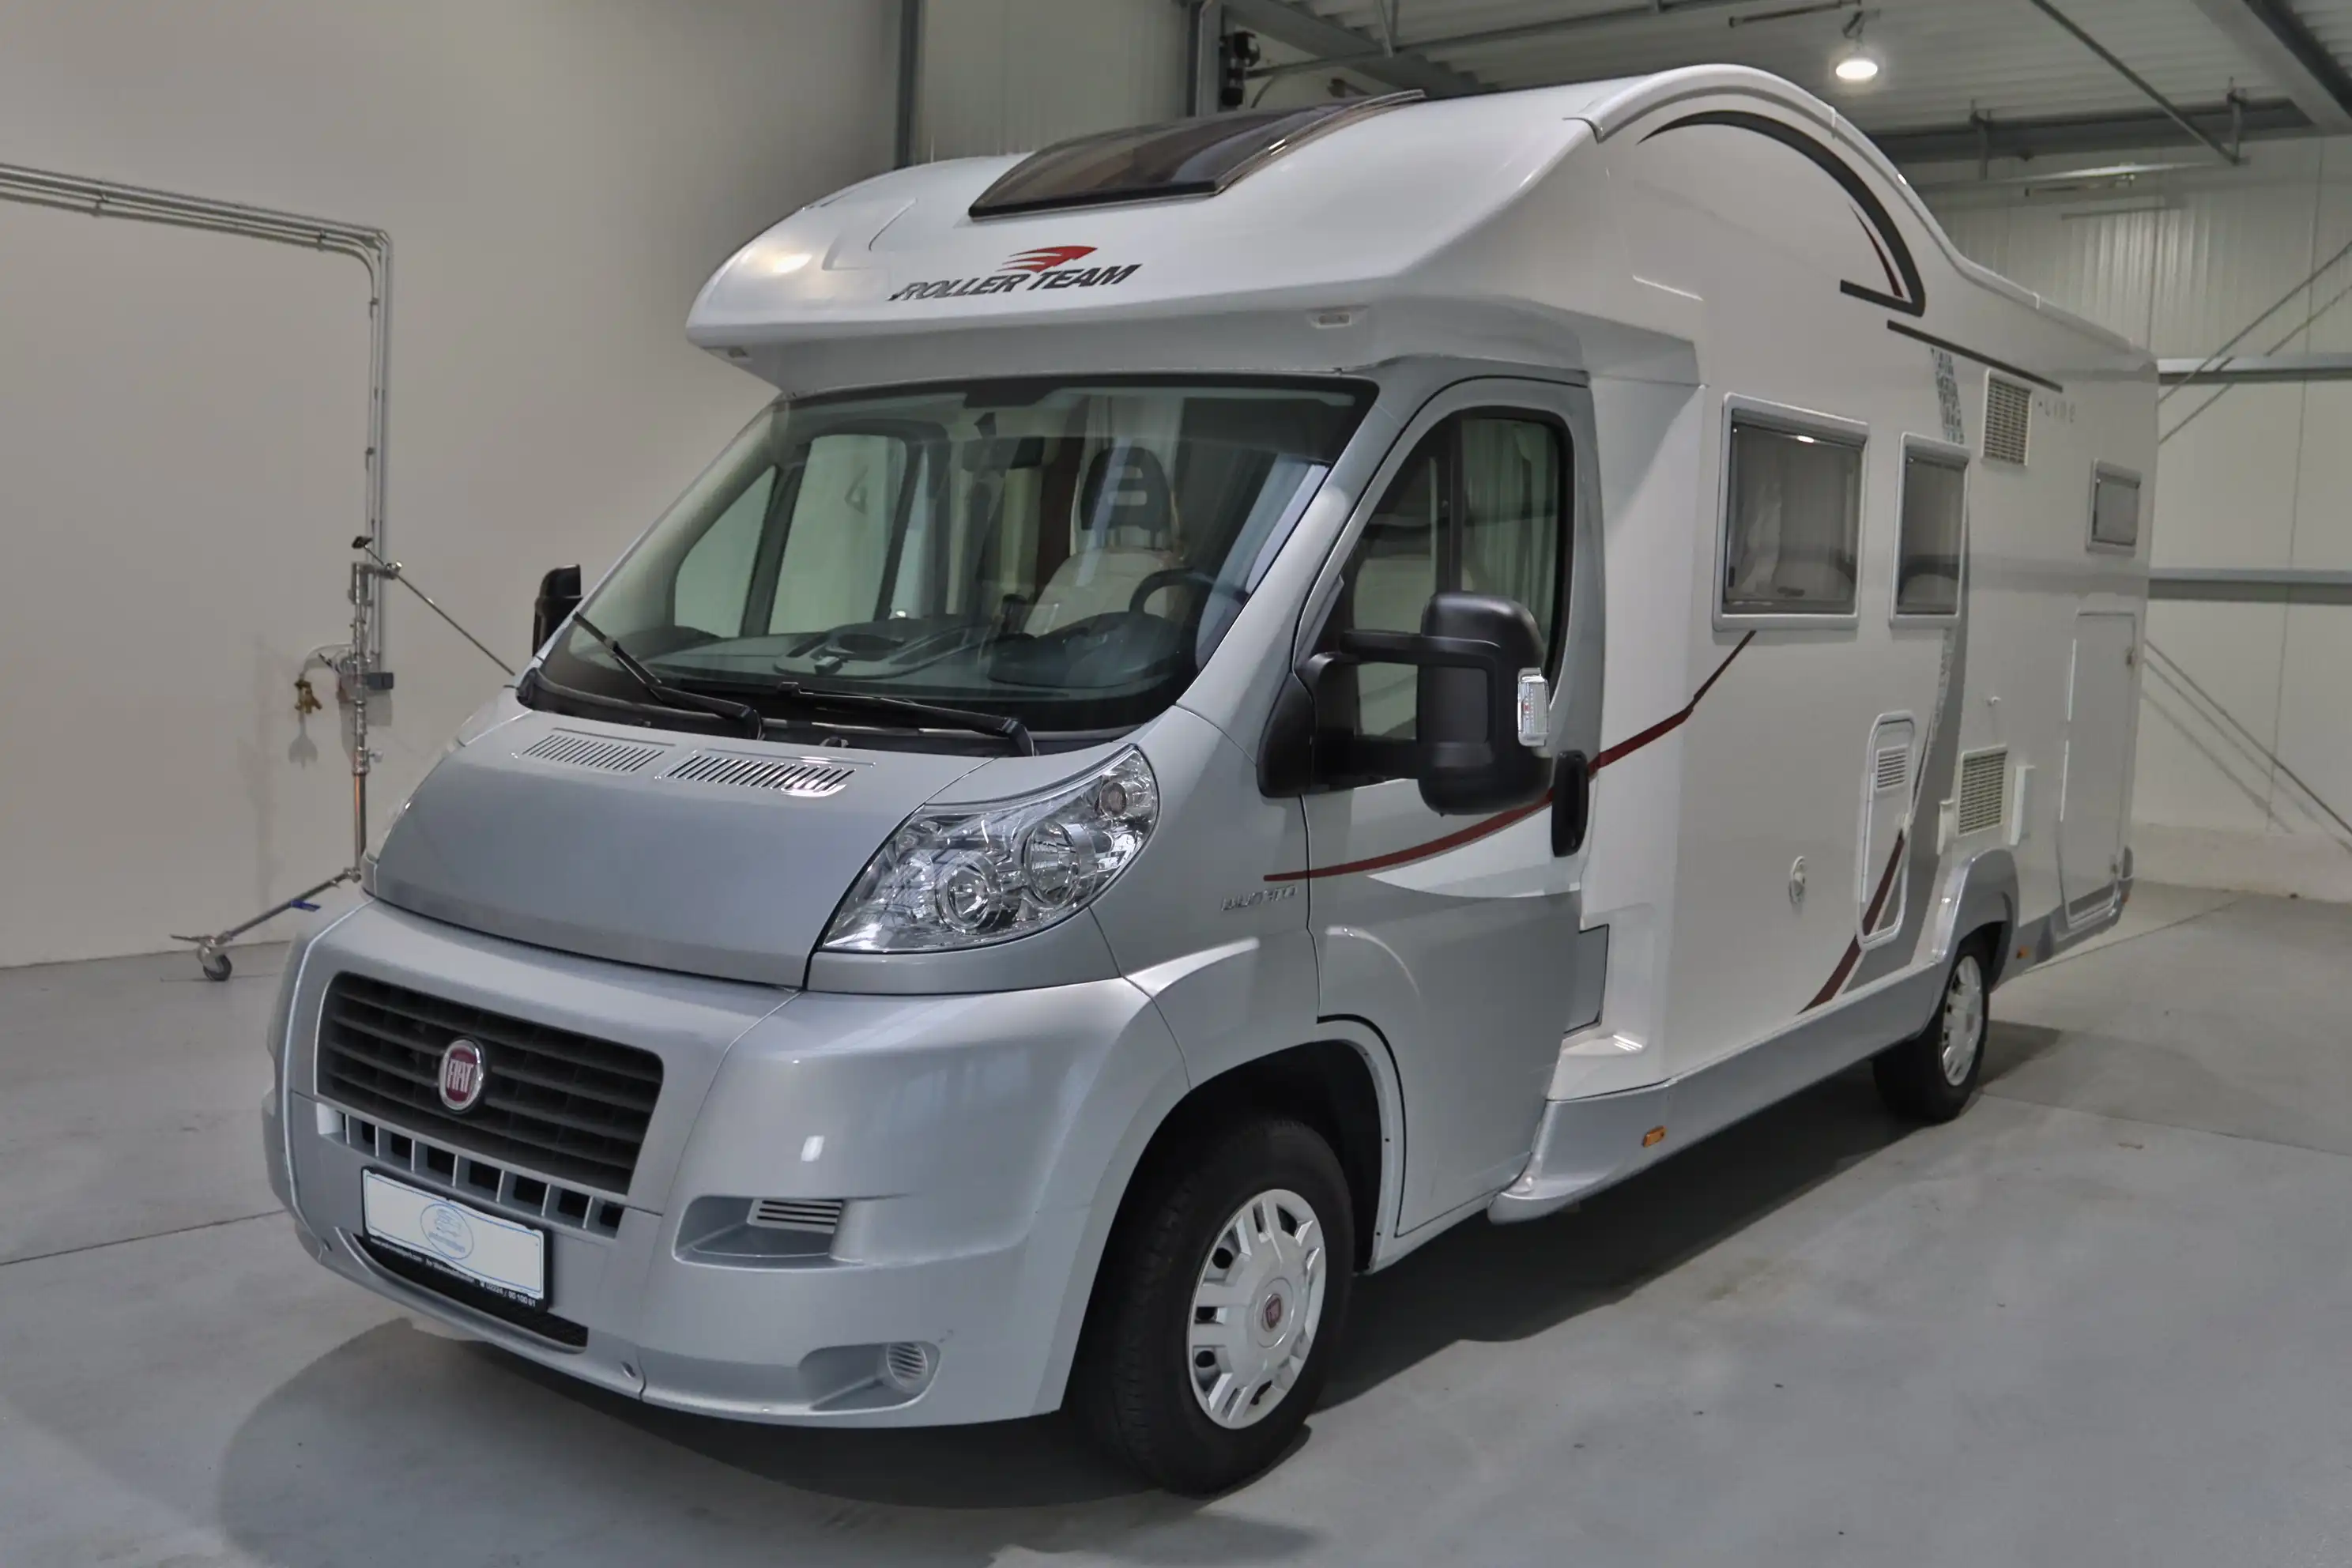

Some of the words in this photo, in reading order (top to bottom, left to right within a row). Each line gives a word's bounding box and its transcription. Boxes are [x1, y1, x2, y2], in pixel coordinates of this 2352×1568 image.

[886, 273, 1031, 302] ROLLER
[1027, 263, 1144, 292] TEAM
[446, 1058, 474, 1093] FIAT
